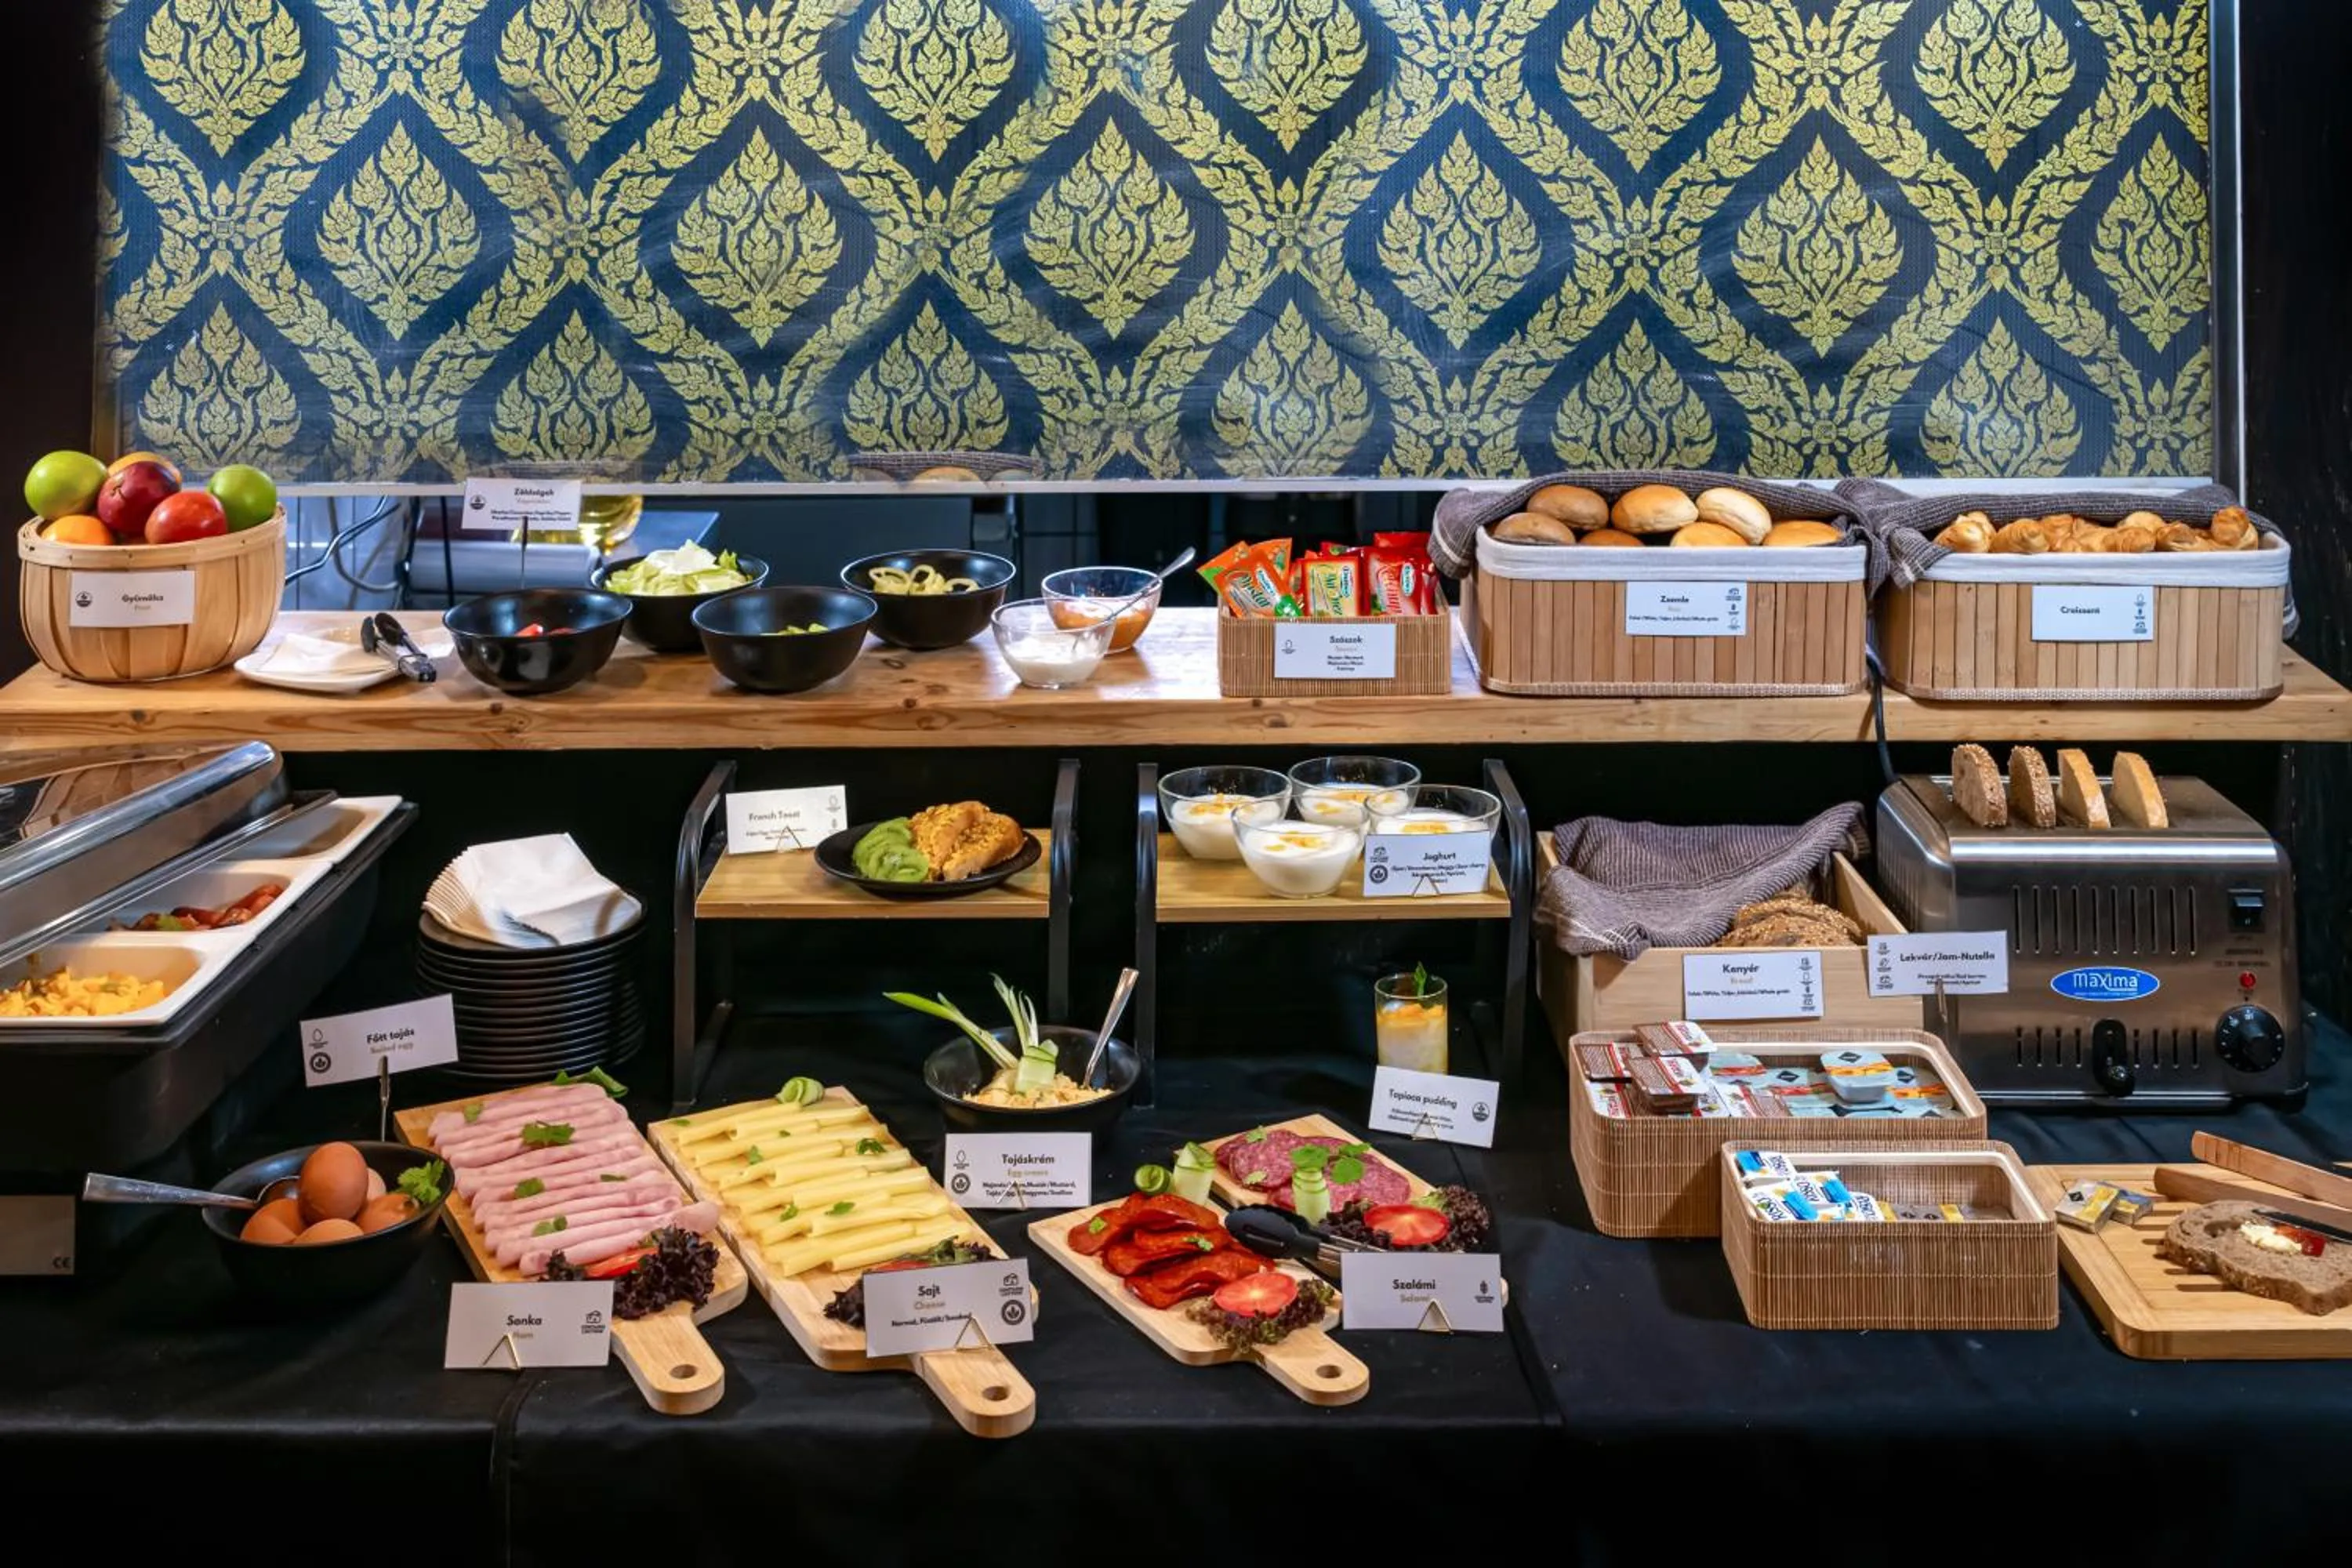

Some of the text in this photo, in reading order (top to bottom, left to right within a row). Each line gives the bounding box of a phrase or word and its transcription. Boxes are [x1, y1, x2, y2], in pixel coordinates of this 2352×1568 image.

[1423, 852, 1456, 862] Joghurt
[1722, 964, 1759, 975] Kenyér
[366, 1027, 415, 1044] Főtt tojás
[1389, 1088, 1457, 1109] Tapioca pudding
[1002, 1153, 1054, 1167] Tojáskrém
[918, 1284, 941, 1298] Sajt
[1392, 1279, 1436, 1290] Szalámi
[506, 1314, 543, 1326] Sonka
